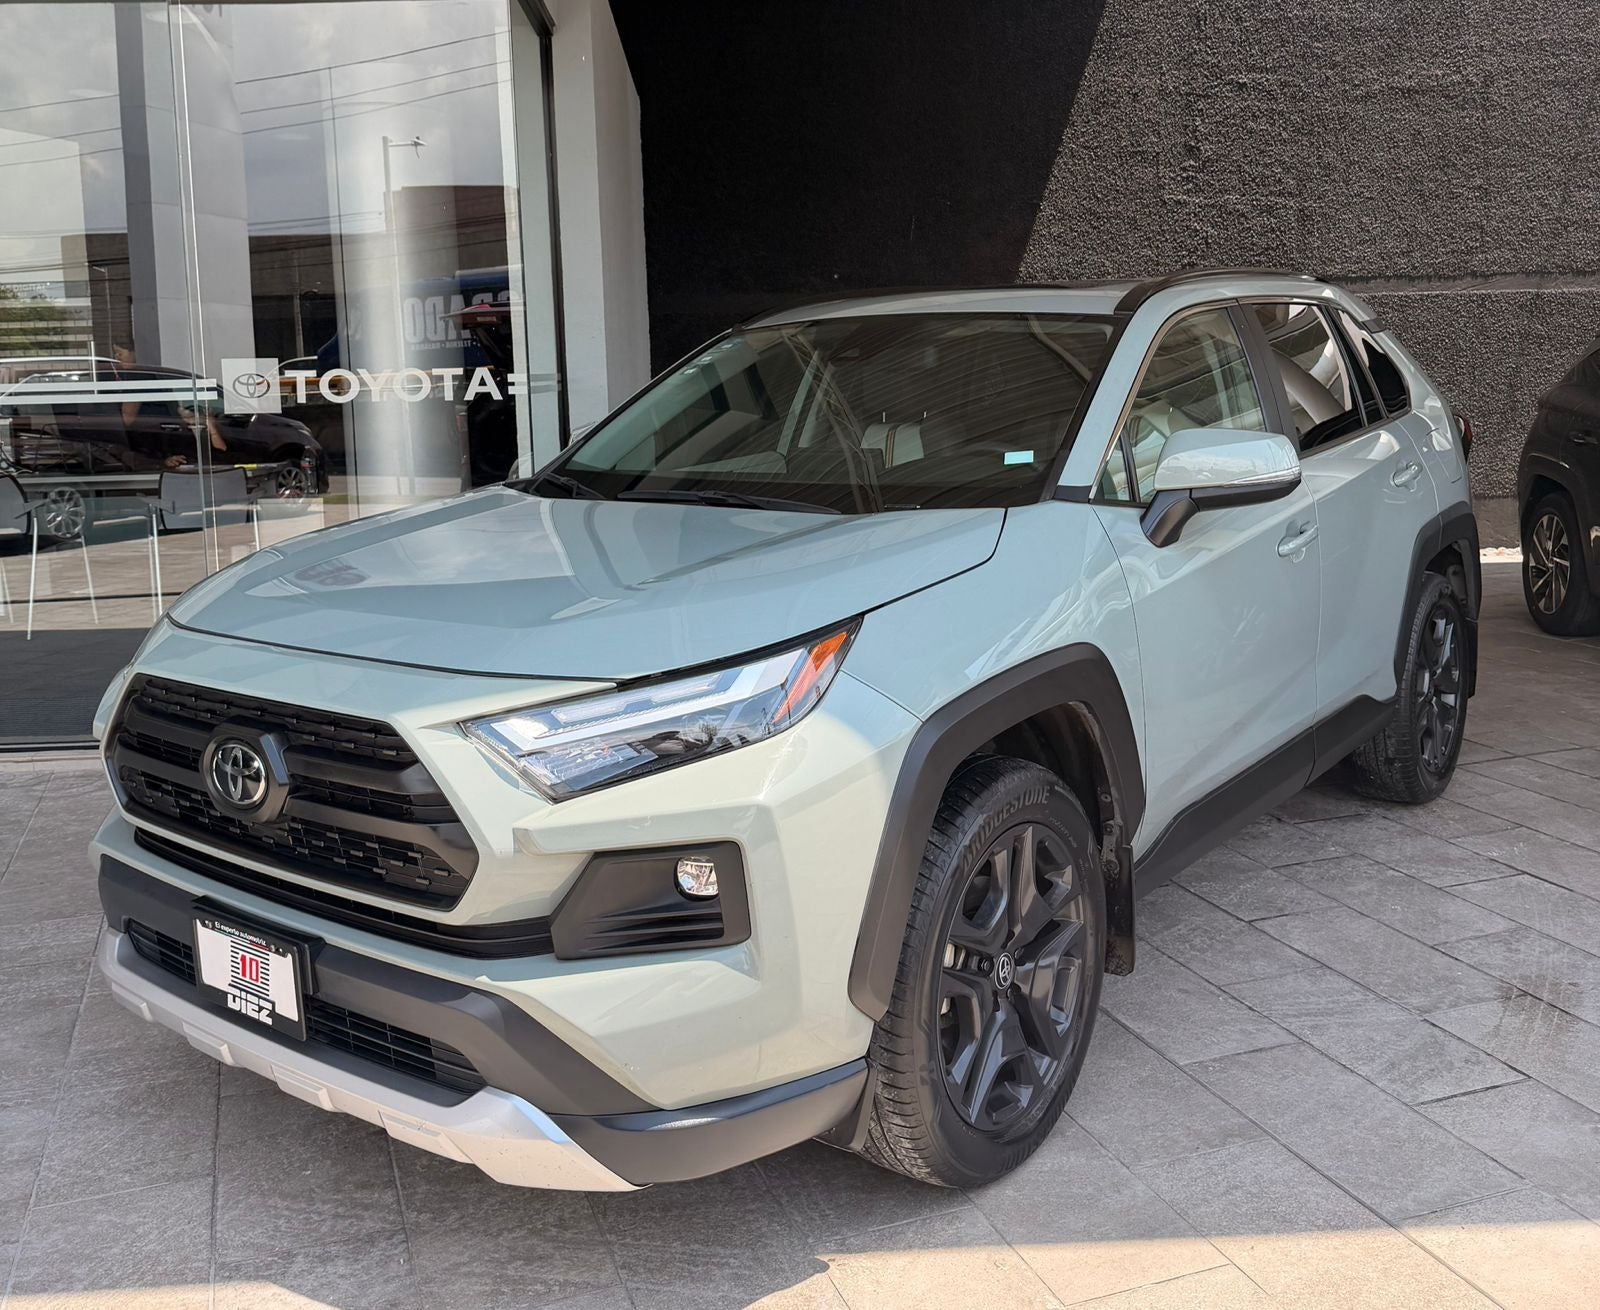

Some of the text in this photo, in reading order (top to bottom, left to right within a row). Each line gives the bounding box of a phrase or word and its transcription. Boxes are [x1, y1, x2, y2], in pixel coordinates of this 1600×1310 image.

[284, 366, 504, 405] TOYOTA
[239, 954, 260, 984] 10
[227, 987, 273, 1026] DIEZ
